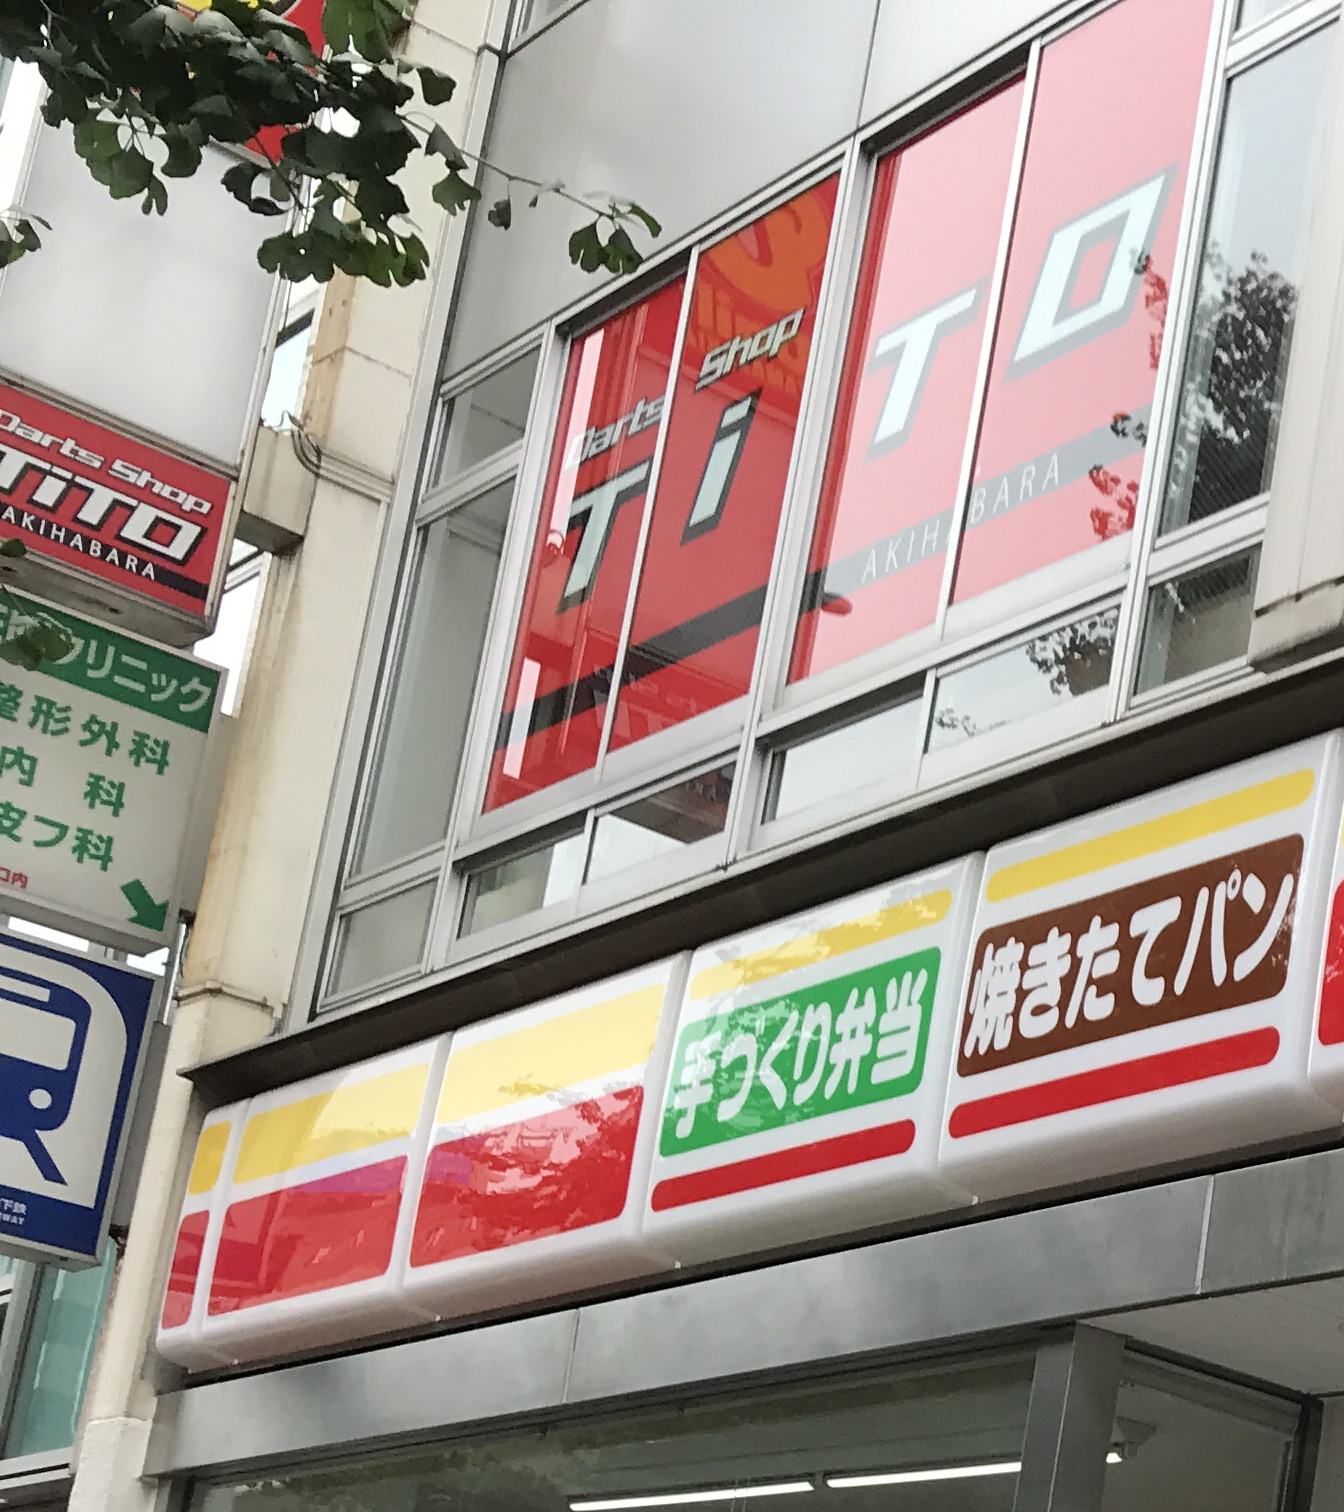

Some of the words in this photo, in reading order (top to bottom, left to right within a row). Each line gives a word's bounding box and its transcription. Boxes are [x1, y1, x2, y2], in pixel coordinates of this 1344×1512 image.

[0, 409, 105, 470] Darts
[107, 458, 213, 516] Shop
[564, 394, 669, 473] Darts
[696, 306, 806, 391] Shop
[1, 505, 156, 581] AKIHABARA
[860, 450, 1063, 585] AKIHBARA
[964, 864, 1295, 1059] 焼きたてパン
[673, 960, 928, 1142] 手づくり弁当
